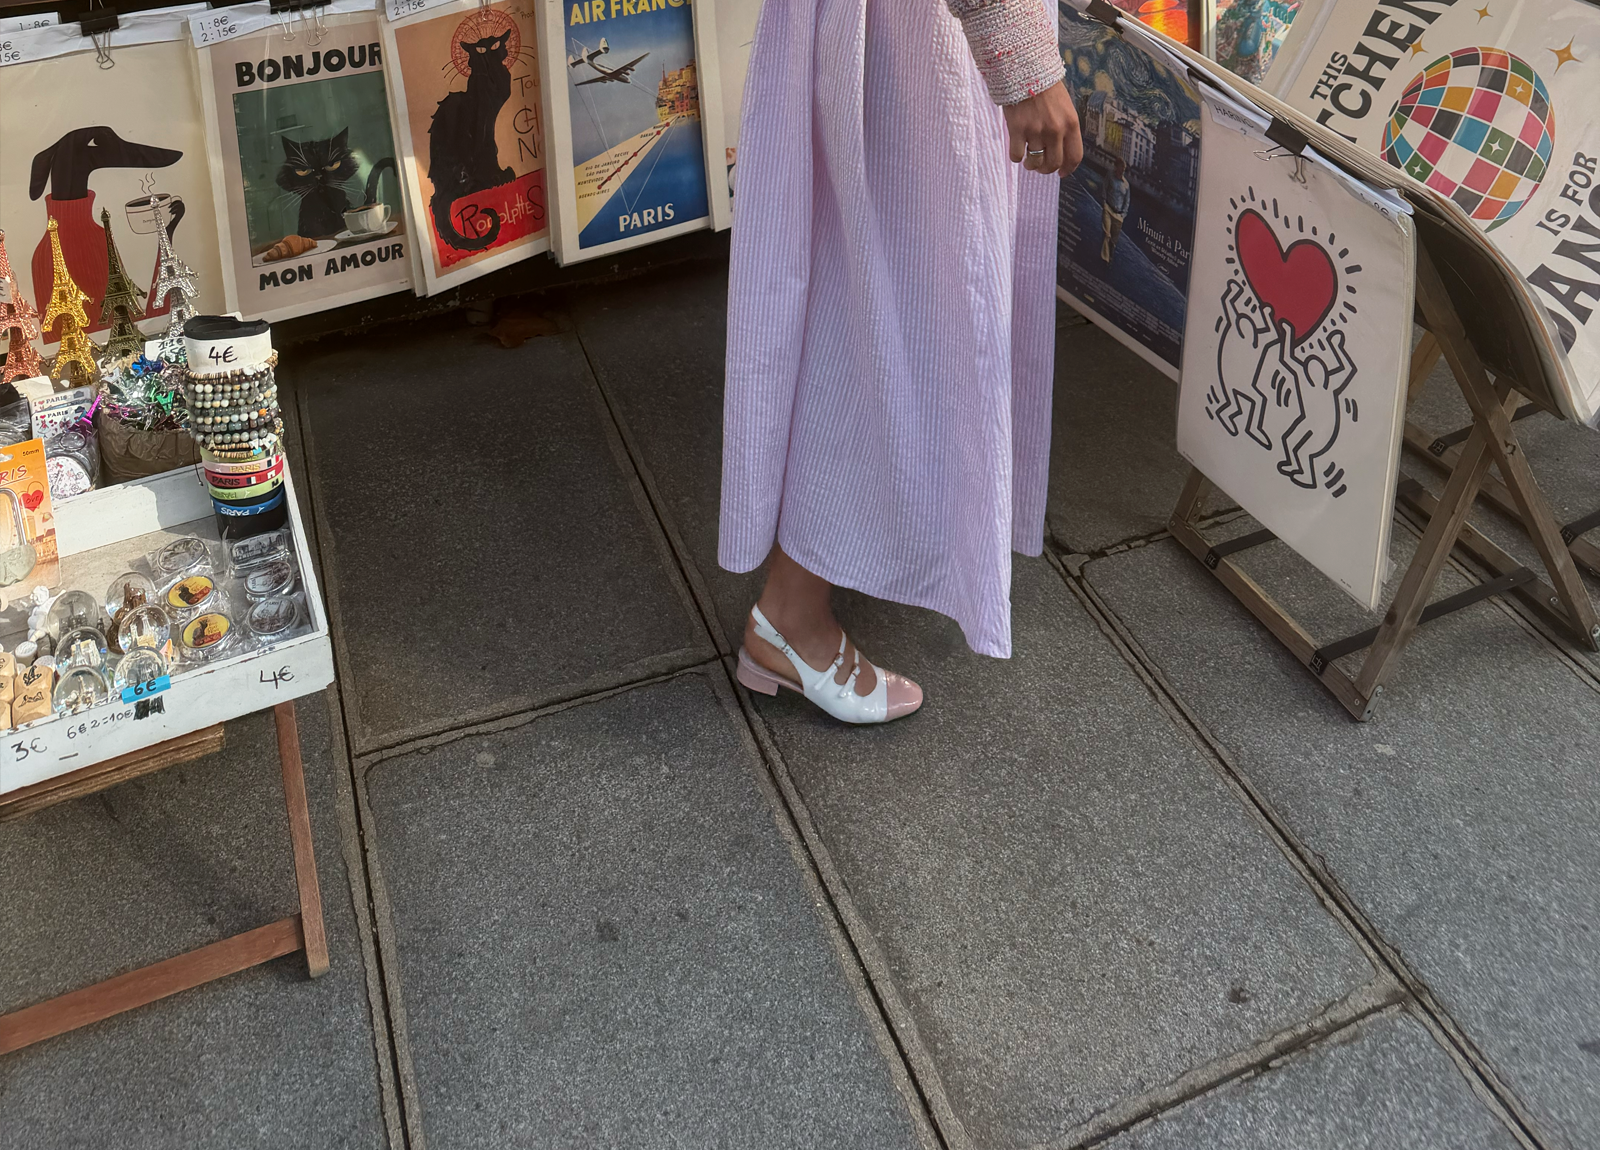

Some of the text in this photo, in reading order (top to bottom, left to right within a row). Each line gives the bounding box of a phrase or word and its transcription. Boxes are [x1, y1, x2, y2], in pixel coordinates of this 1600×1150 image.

[570, 1, 607, 27] AIR
[235, 41, 383, 88] BONJOUR
[1309, 50, 1349, 101] THIS
[1535, 150, 1598, 237] IS FOR
[618, 203, 676, 232] PARIS
[1136, 216, 1166, 244] Minuit
[258, 242, 405, 292] MON AMOUR
[208, 345, 239, 366] 4€
[46, 395, 69, 405] PARIS
[48, 409, 71, 420] PARIS
[211, 475, 241, 487] PARIS
[230, 463, 261, 474] PARIS
[220, 506, 251, 518] PARIS
[133, 678, 158, 697] 6€
[259, 665, 296, 691] 4€
[67, 722, 88, 740] 6€
[11, 735, 49, 762] 3€
